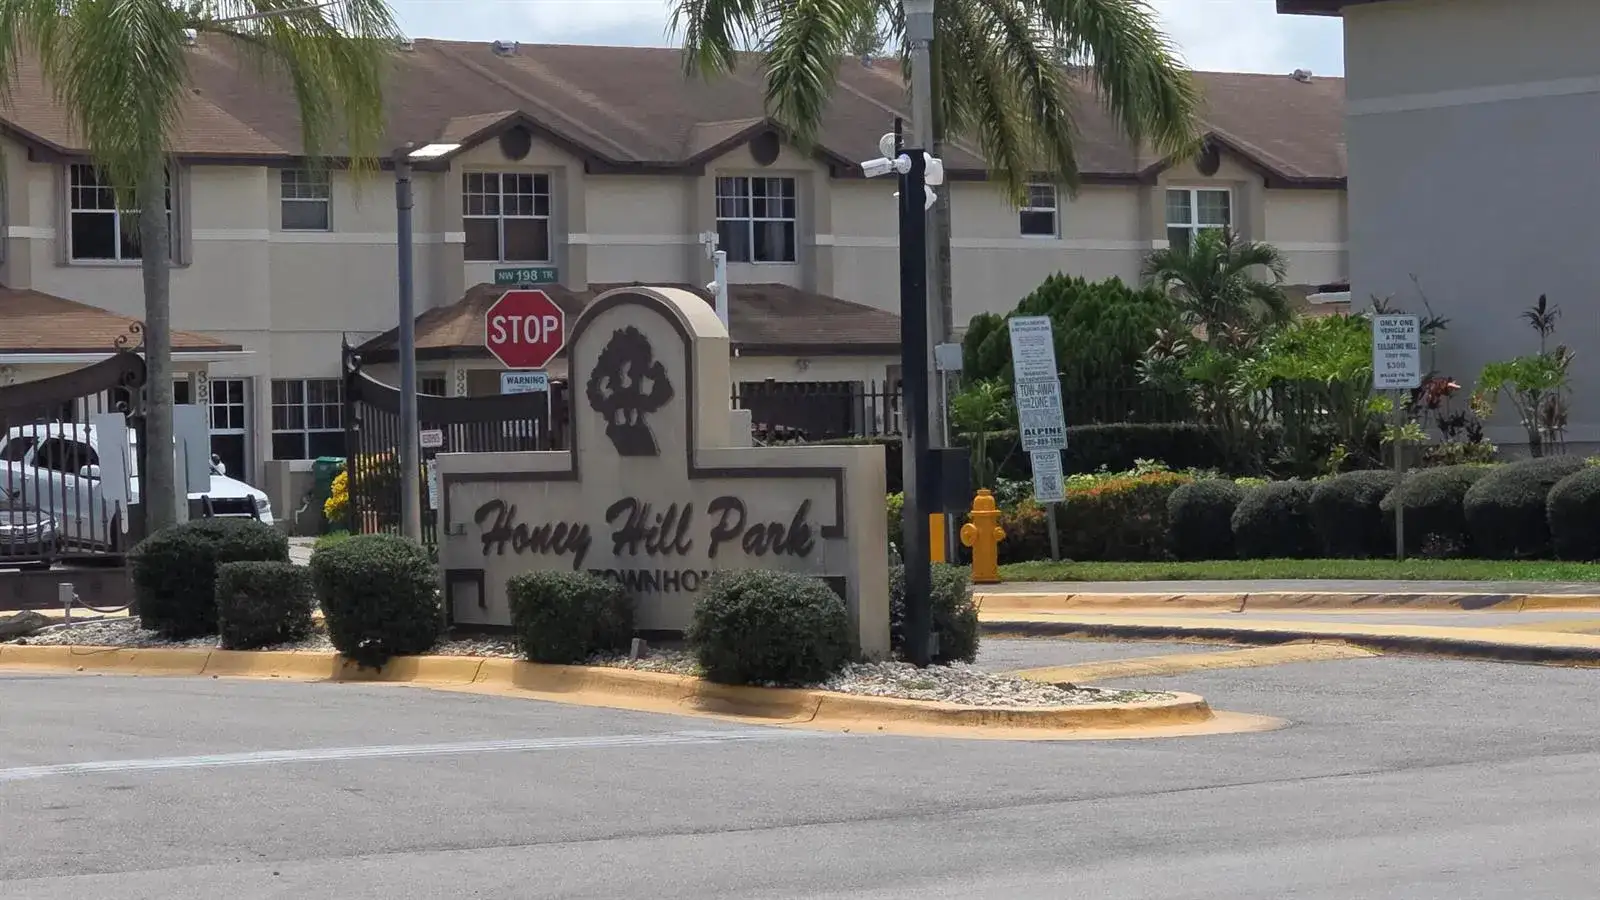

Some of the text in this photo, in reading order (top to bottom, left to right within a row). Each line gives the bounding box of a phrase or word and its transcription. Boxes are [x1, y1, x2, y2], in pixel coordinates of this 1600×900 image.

[499, 270, 554, 281] NW 198 TR
[491, 315, 558, 344] STOP
[506, 376, 544, 384] WARNING
[1020, 383, 1056, 398] TOW-AWAY
[1030, 396, 1049, 408] ZONE
[1024, 427, 1062, 436] ALPINE
[474, 496, 817, 570] Honey Hill Park
[587, 568, 716, 593] TOWNHO
